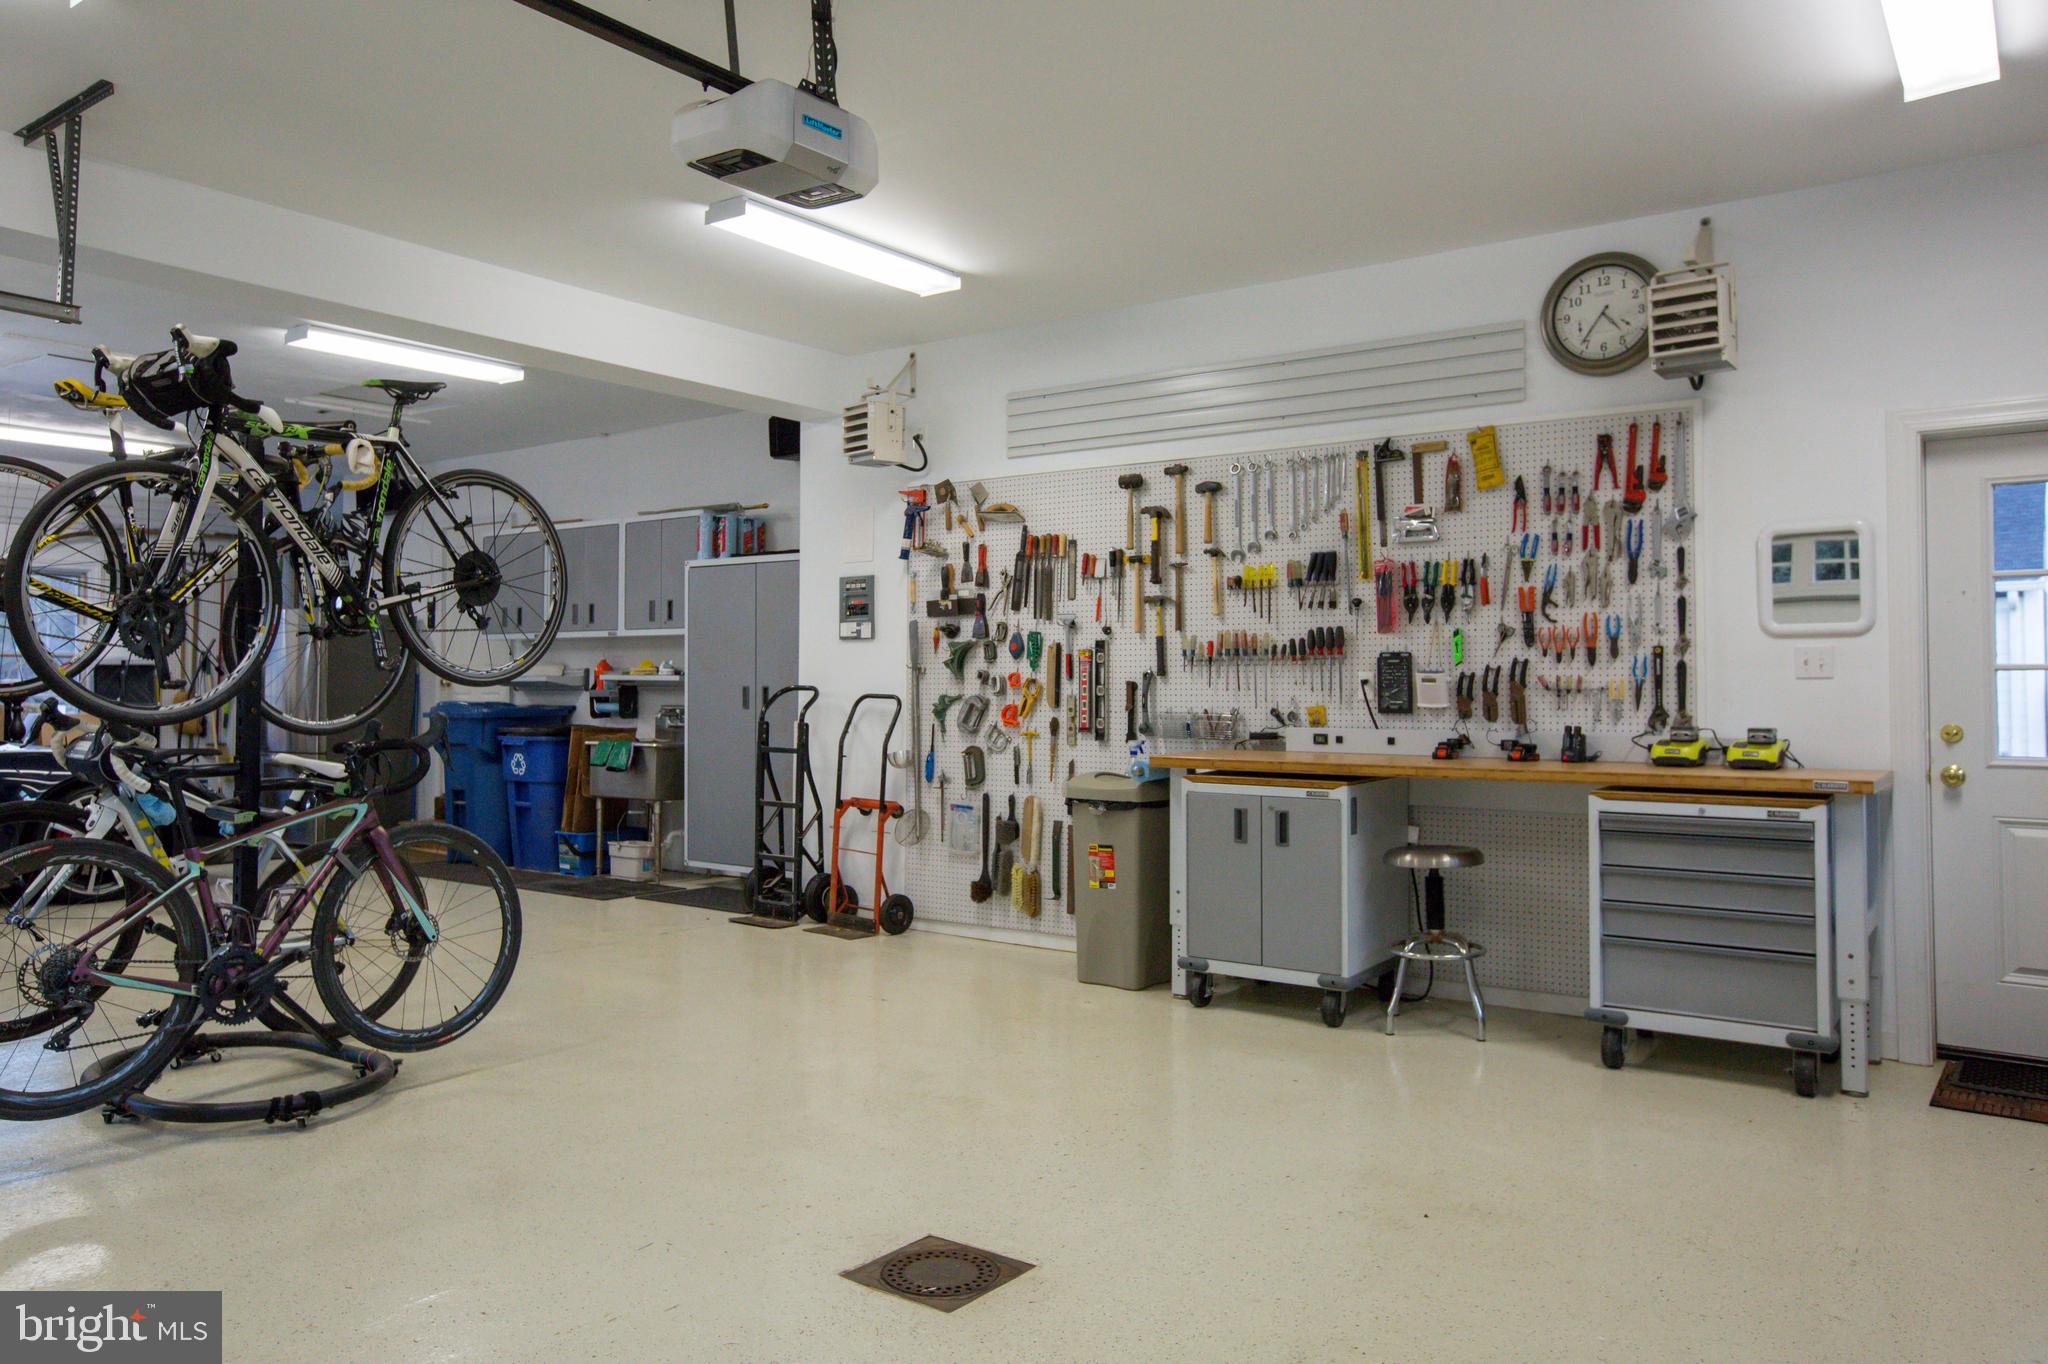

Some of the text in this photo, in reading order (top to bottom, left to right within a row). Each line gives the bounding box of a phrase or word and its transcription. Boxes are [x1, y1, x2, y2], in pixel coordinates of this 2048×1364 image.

[1597, 275, 1611, 287] 12
[1621, 279, 1626, 289] 1
[1579, 284, 1591, 295] 11
[1631, 288, 1639, 299] 2
[1568, 297, 1582, 308] 10
[1637, 303, 1645, 314] 3
[1563, 314, 1571, 324] 9
[1584, 339, 1591, 349] 7
[1618, 335, 1626, 345] 5
[1600, 342, 1608, 352] 6
[372, 458, 393, 549] canondale
